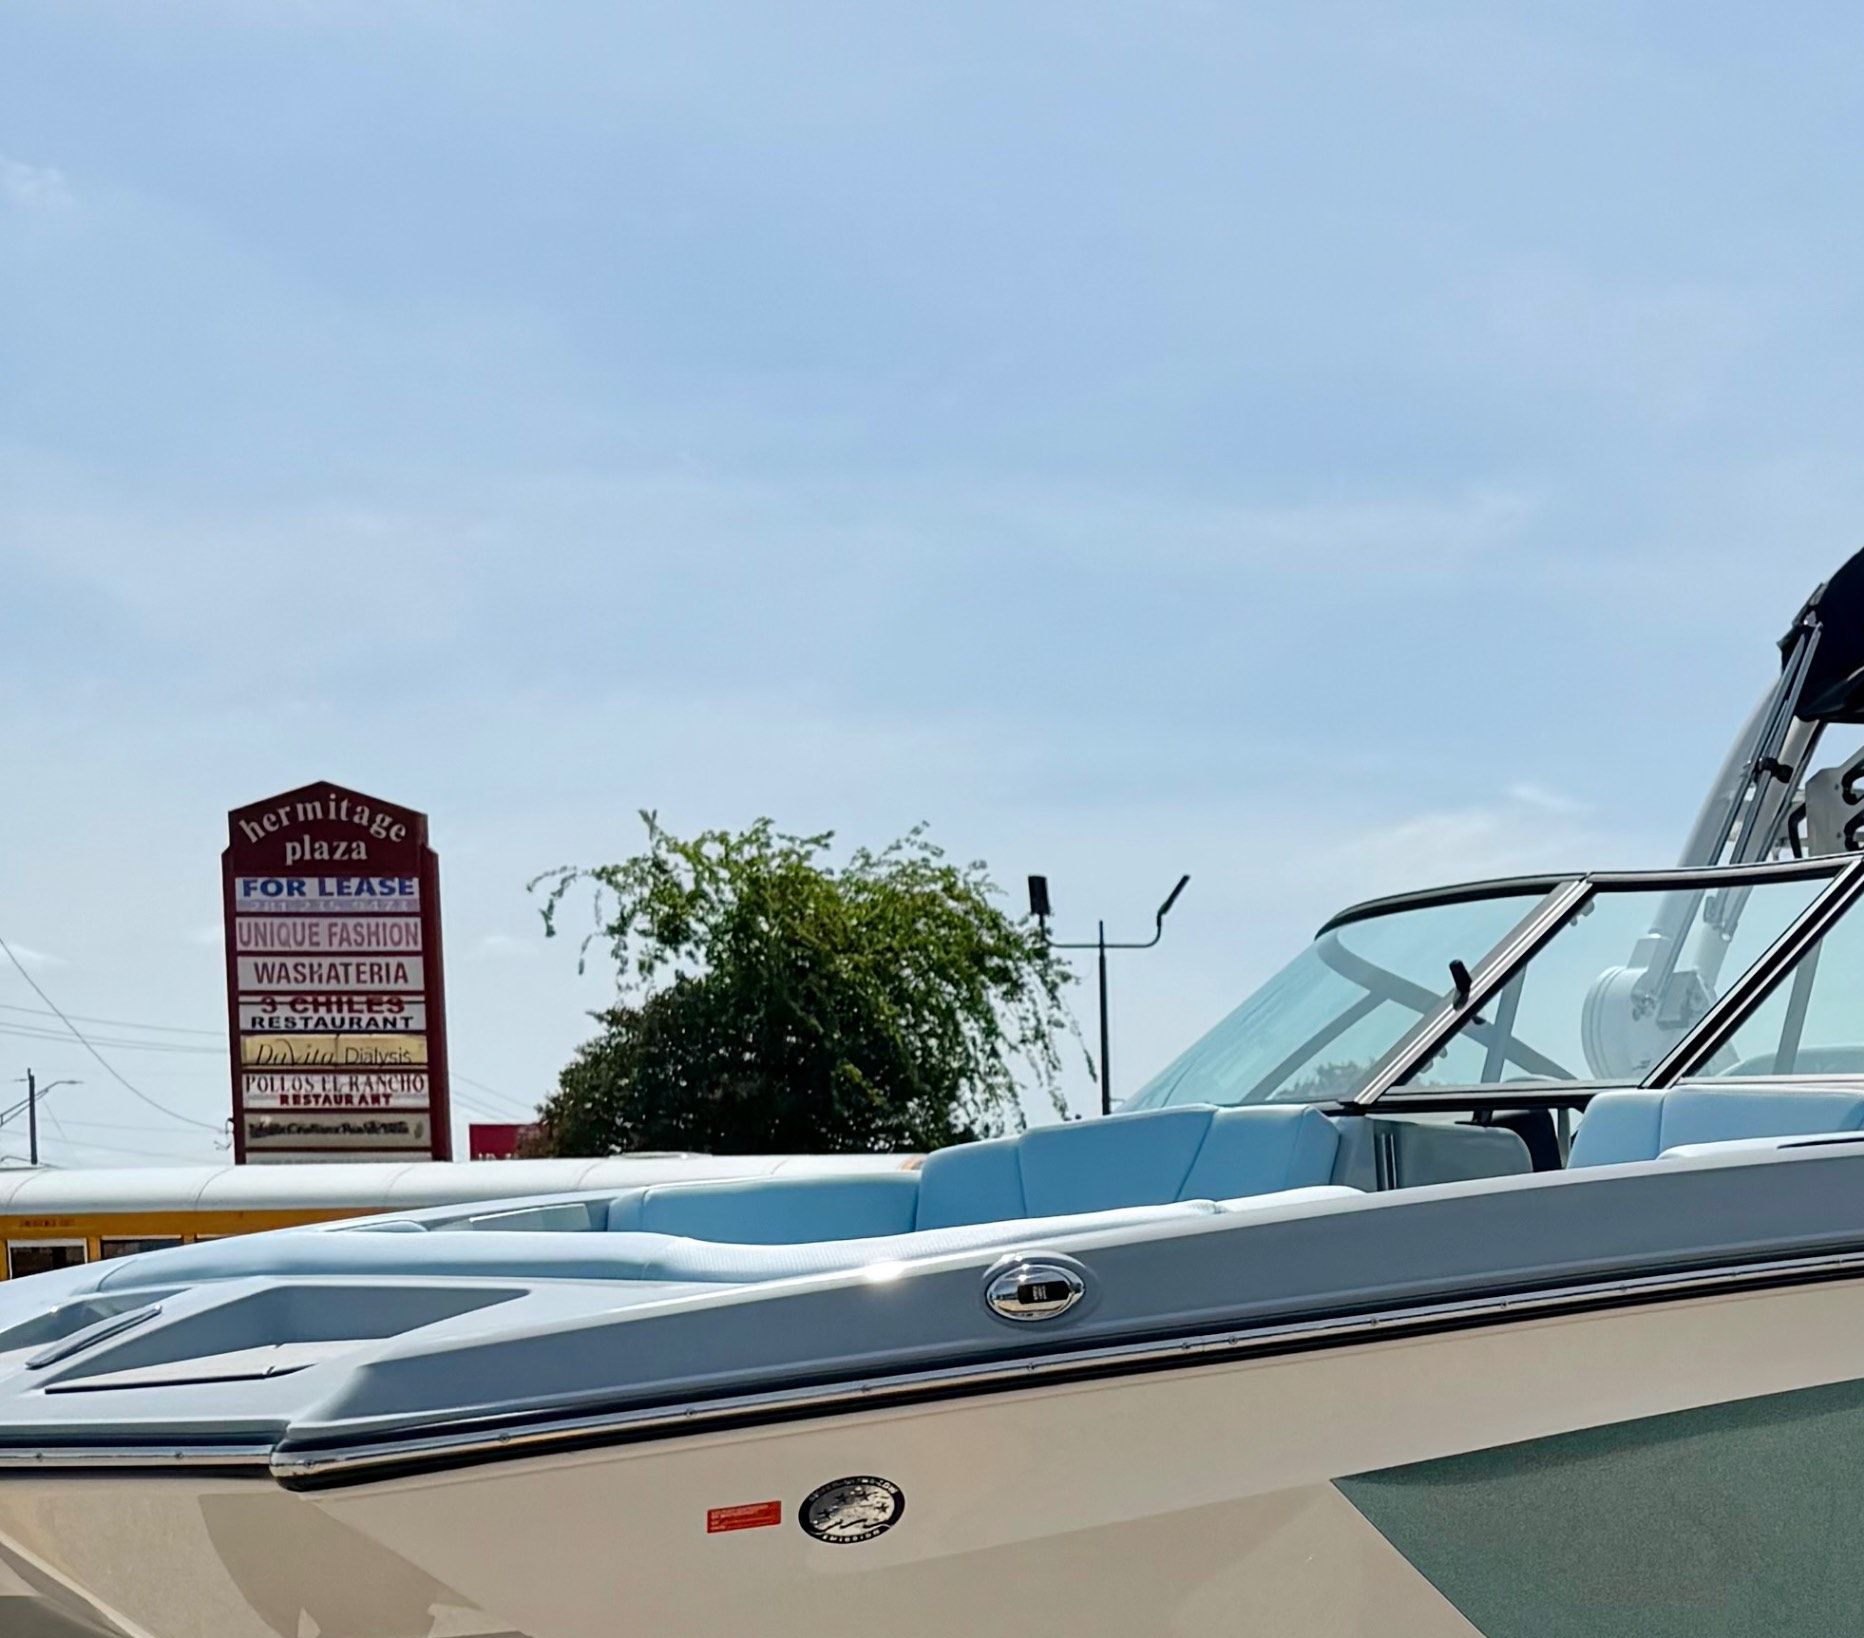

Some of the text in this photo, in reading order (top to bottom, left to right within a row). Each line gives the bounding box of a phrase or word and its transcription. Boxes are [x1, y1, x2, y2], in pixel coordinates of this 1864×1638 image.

[239, 793, 406, 843] hermitage
[285, 834, 368, 866] plaza
[243, 877, 414, 898] FOR LEASE
[238, 922, 418, 949] UNIQUE FASHION
[261, 996, 405, 1014] 3 CHILES
[251, 1016, 414, 1030] RESTAURANT
[256, 1038, 412, 1067] DaVita Dialysis
[246, 1075, 315, 1093] POLLOS
[349, 1074, 425, 1093] RANCHO
[280, 1093, 393, 1106] RESTAURANT
